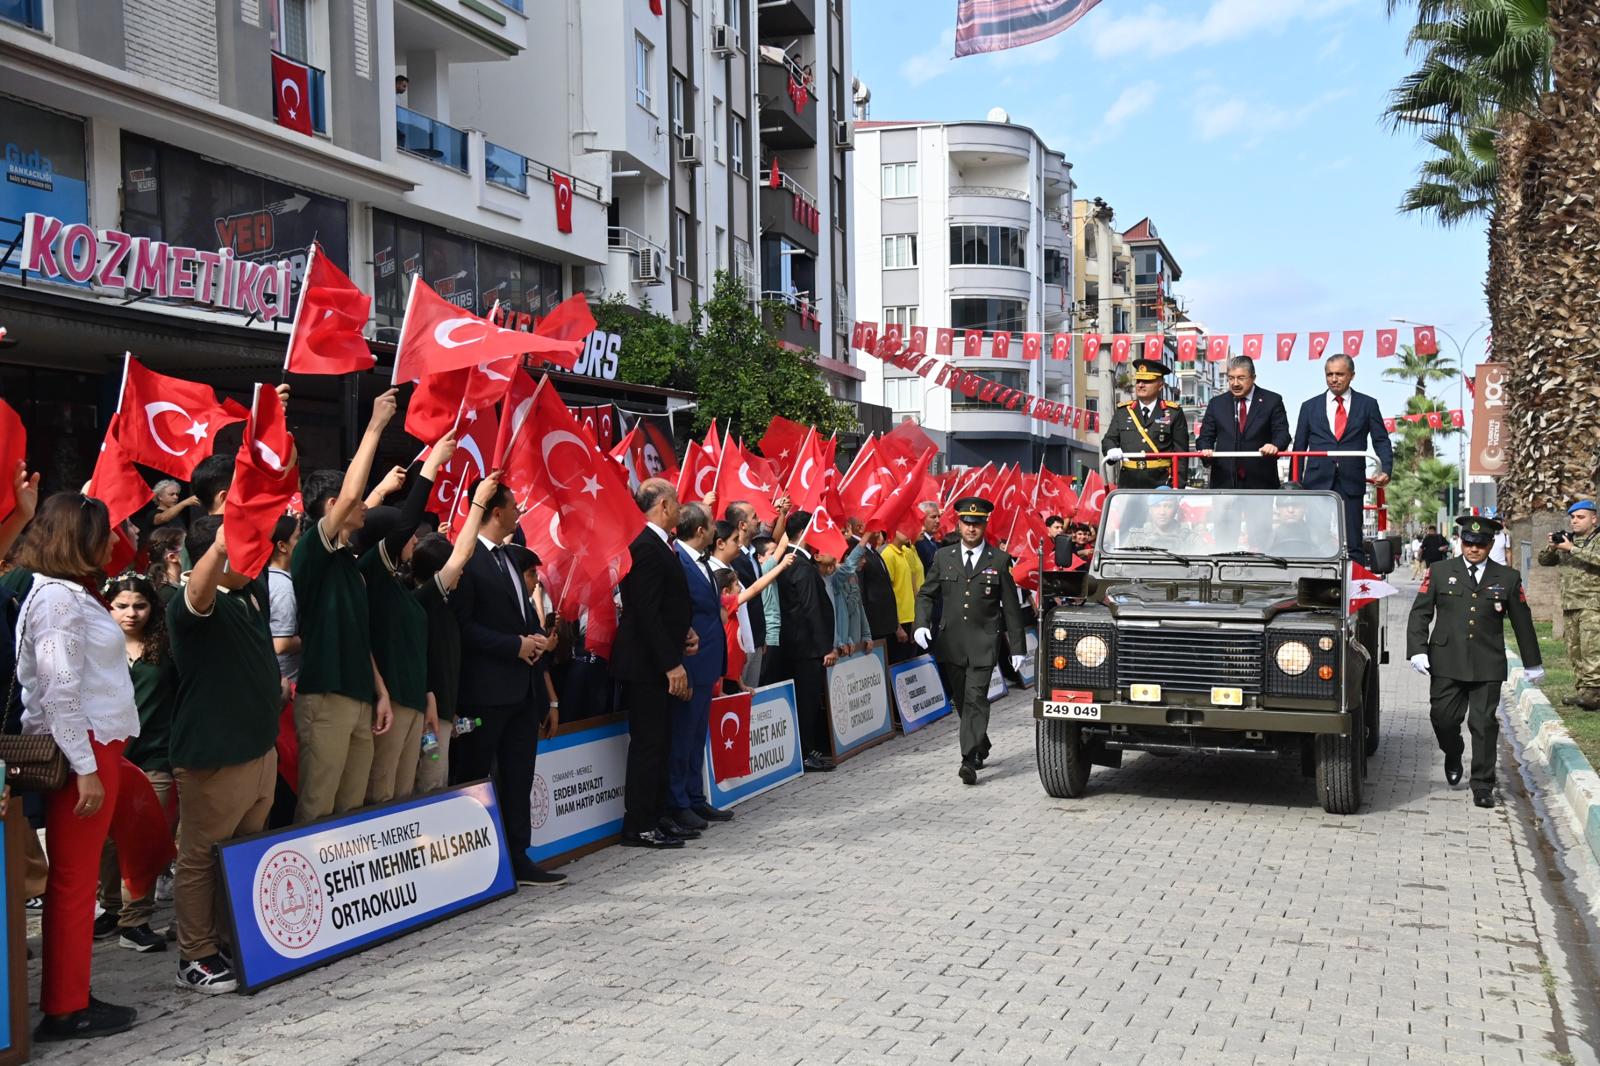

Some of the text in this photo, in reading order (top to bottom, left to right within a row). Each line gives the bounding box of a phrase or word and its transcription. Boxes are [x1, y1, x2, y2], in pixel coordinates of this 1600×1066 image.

[215, 210, 275, 257] YED
[20, 212, 292, 322] KOZMETİKÇİ
[555, 330, 622, 380] URS
[1045, 704, 1098, 717] 249 049
[750, 725, 769, 748] HMET
[750, 745, 785, 773] TAOKULU
[553, 776, 604, 801] ERDEM BAYAZIT
[556, 801, 576, 817] İMAM
[576, 793, 595, 811] HATİP
[595, 786, 626, 804] ORTAOKU
[319, 821, 422, 865] OSMANİYE-MERKEZ
[324, 827, 491, 902] ŞEHİT MEHMET ALİ SARAK
[331, 881, 417, 930] ORTAOKULU
